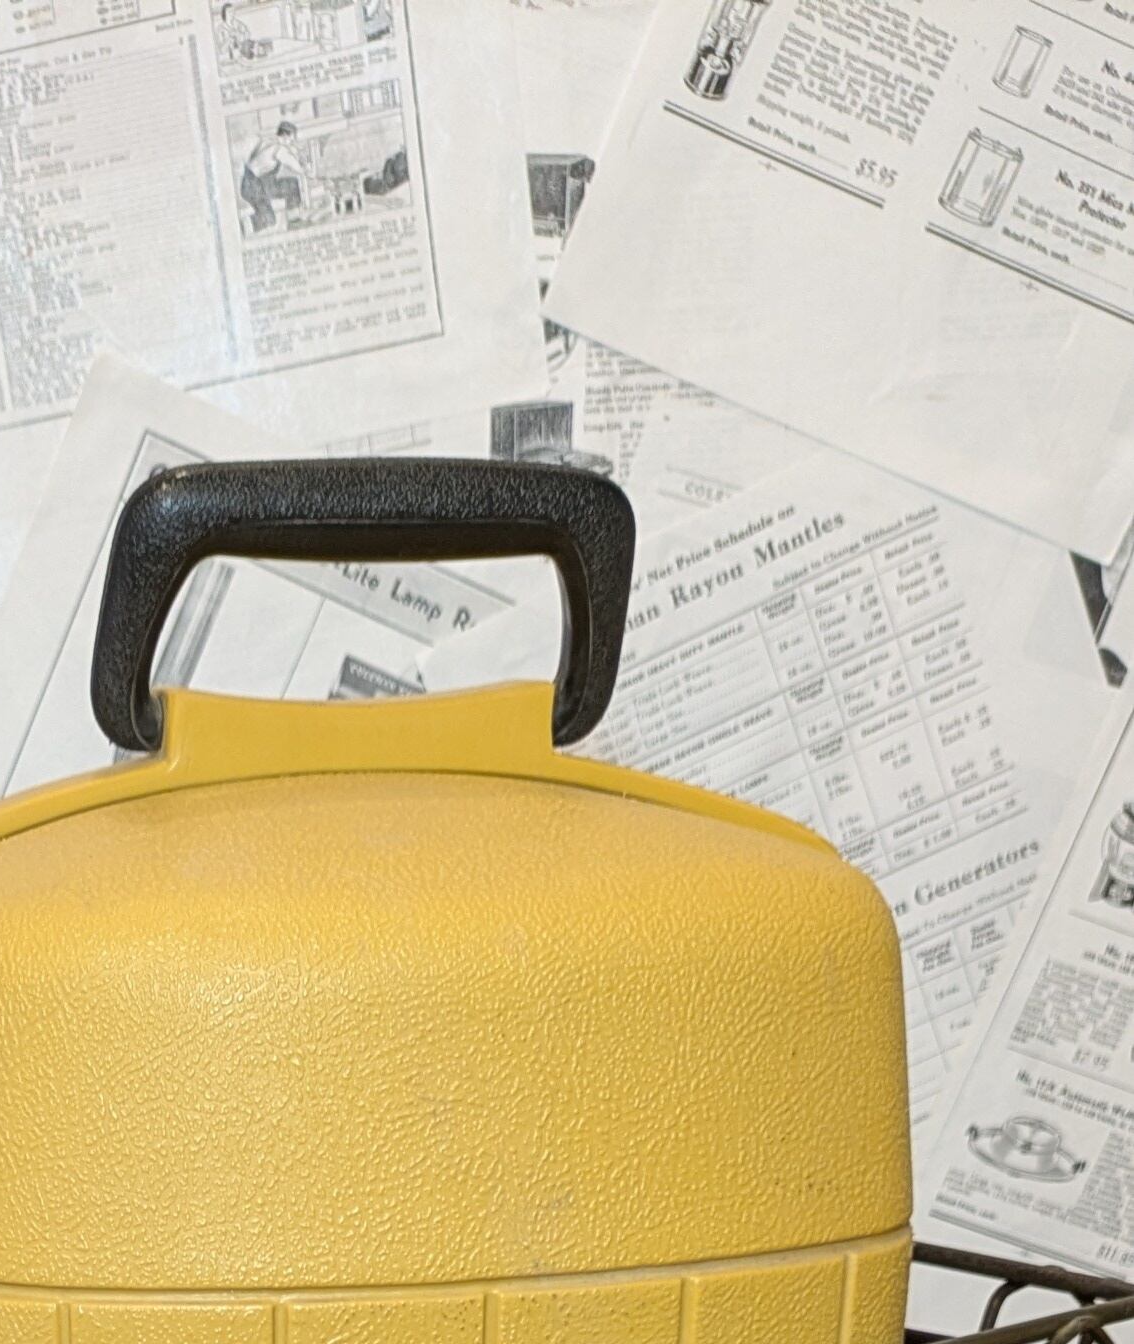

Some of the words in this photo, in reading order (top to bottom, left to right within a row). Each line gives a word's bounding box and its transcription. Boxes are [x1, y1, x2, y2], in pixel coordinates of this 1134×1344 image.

[669, 562, 745, 609] Rayon
[752, 511, 846, 570] Mantles
[390, 579, 442, 623] Lamp
[914, 838, 1041, 906] Generators
